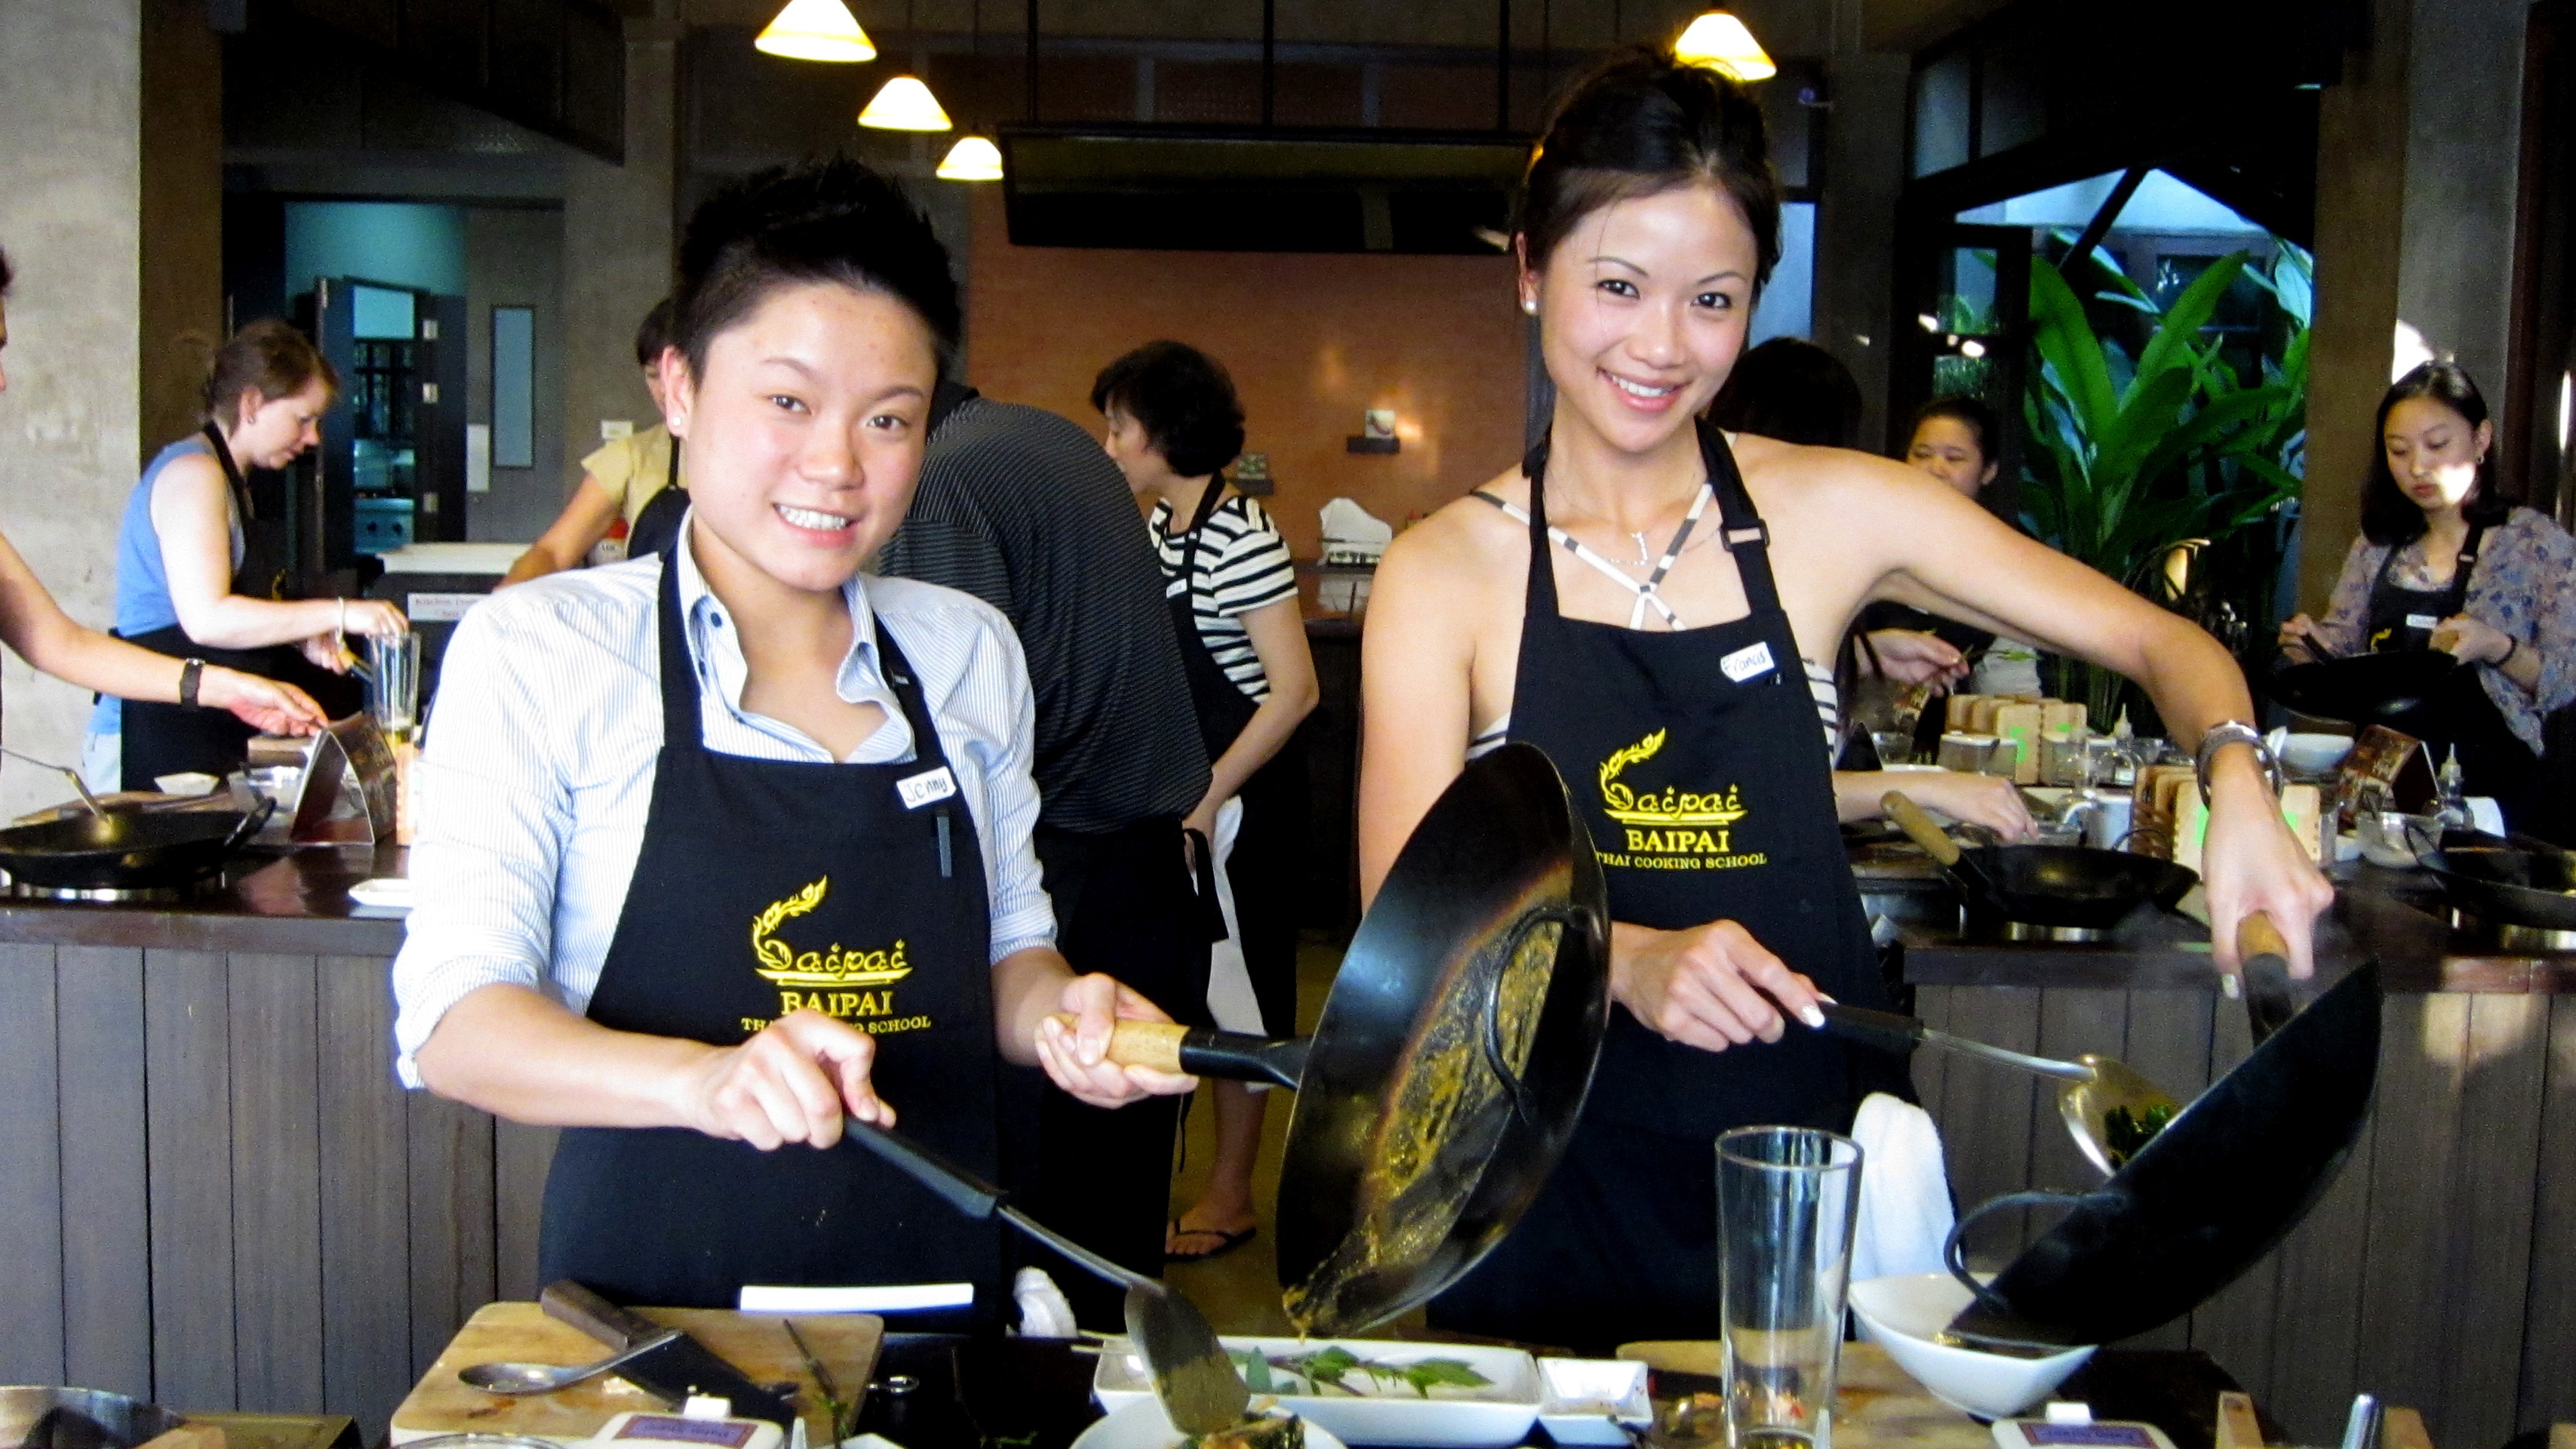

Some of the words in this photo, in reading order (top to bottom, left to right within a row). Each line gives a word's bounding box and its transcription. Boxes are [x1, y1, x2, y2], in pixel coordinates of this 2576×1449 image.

[1625, 828, 1730, 854] BAIPAI
[1595, 851, 1631, 867] THAI
[1634, 856, 1701, 870] COOKING
[1705, 852, 1768, 869] SCHOOL
[779, 990, 894, 1017] BAIPAI
[868, 1015, 932, 1035] SCHOOL
